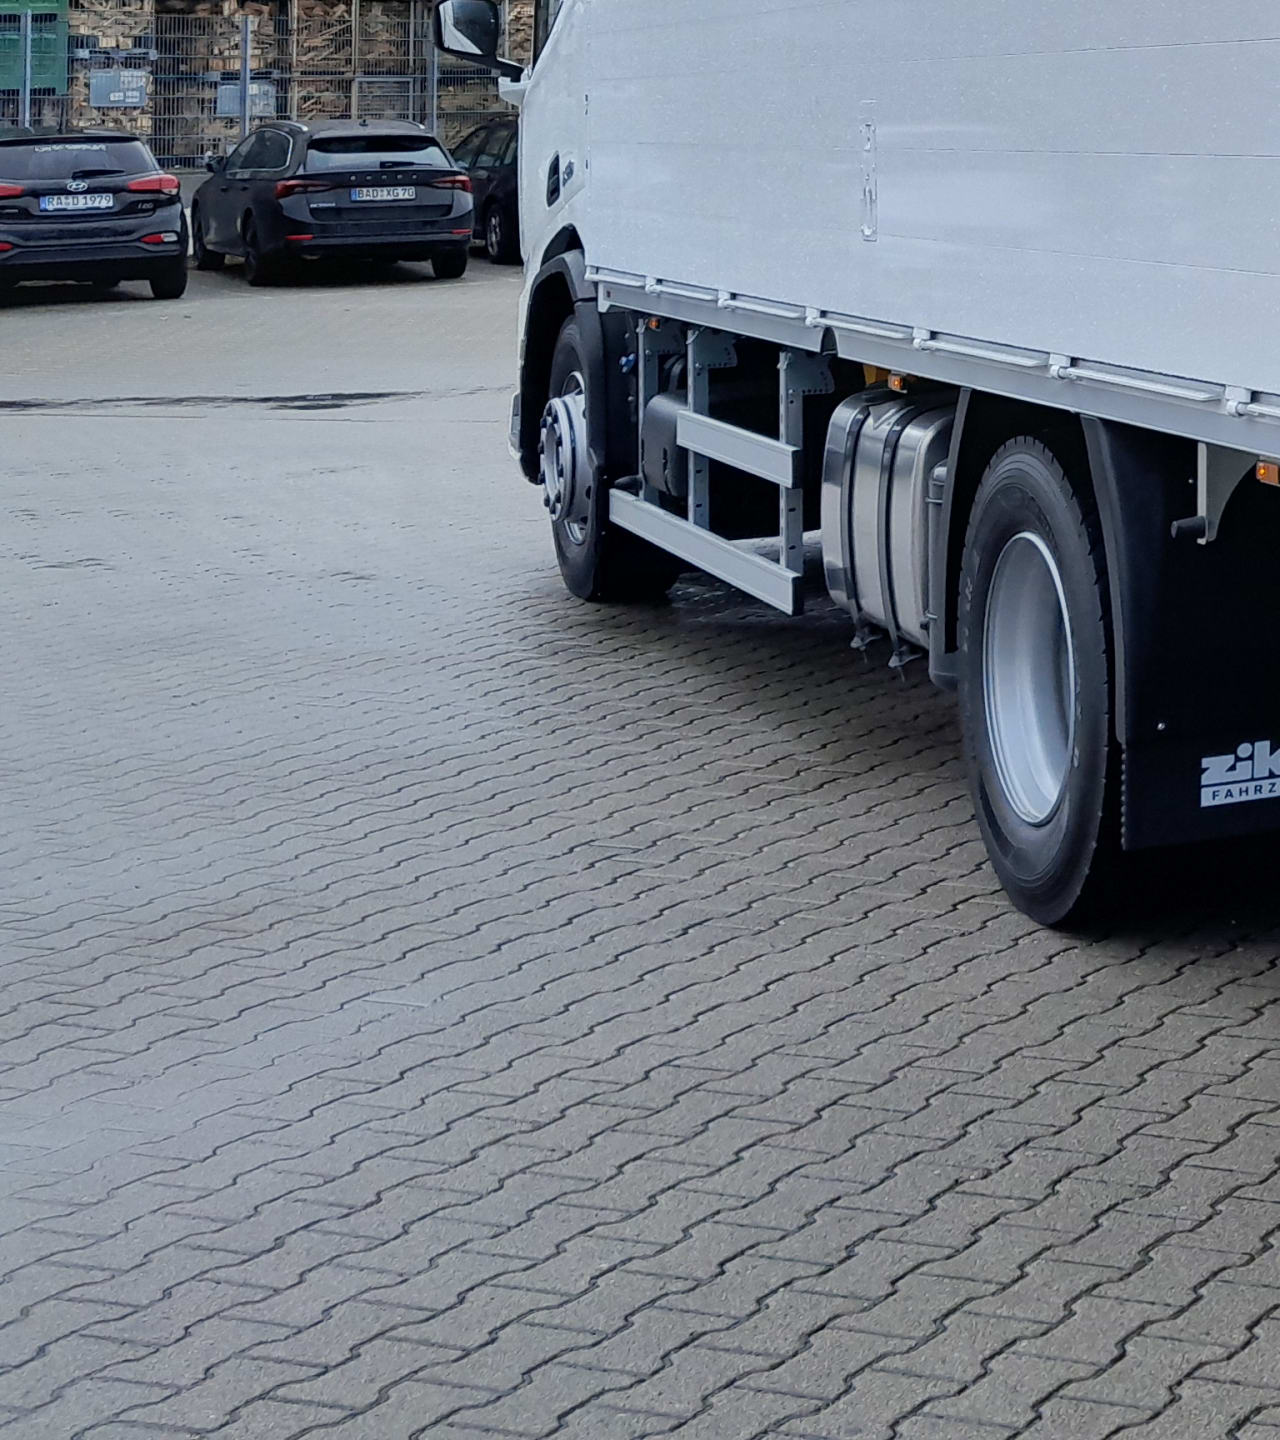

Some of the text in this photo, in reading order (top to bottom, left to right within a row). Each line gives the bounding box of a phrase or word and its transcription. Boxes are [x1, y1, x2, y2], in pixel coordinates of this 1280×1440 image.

[357, 187, 379, 199] BAD
[386, 186, 400, 198] XG
[47, 196, 63, 207] RA
[82, 194, 112, 206] 1979
